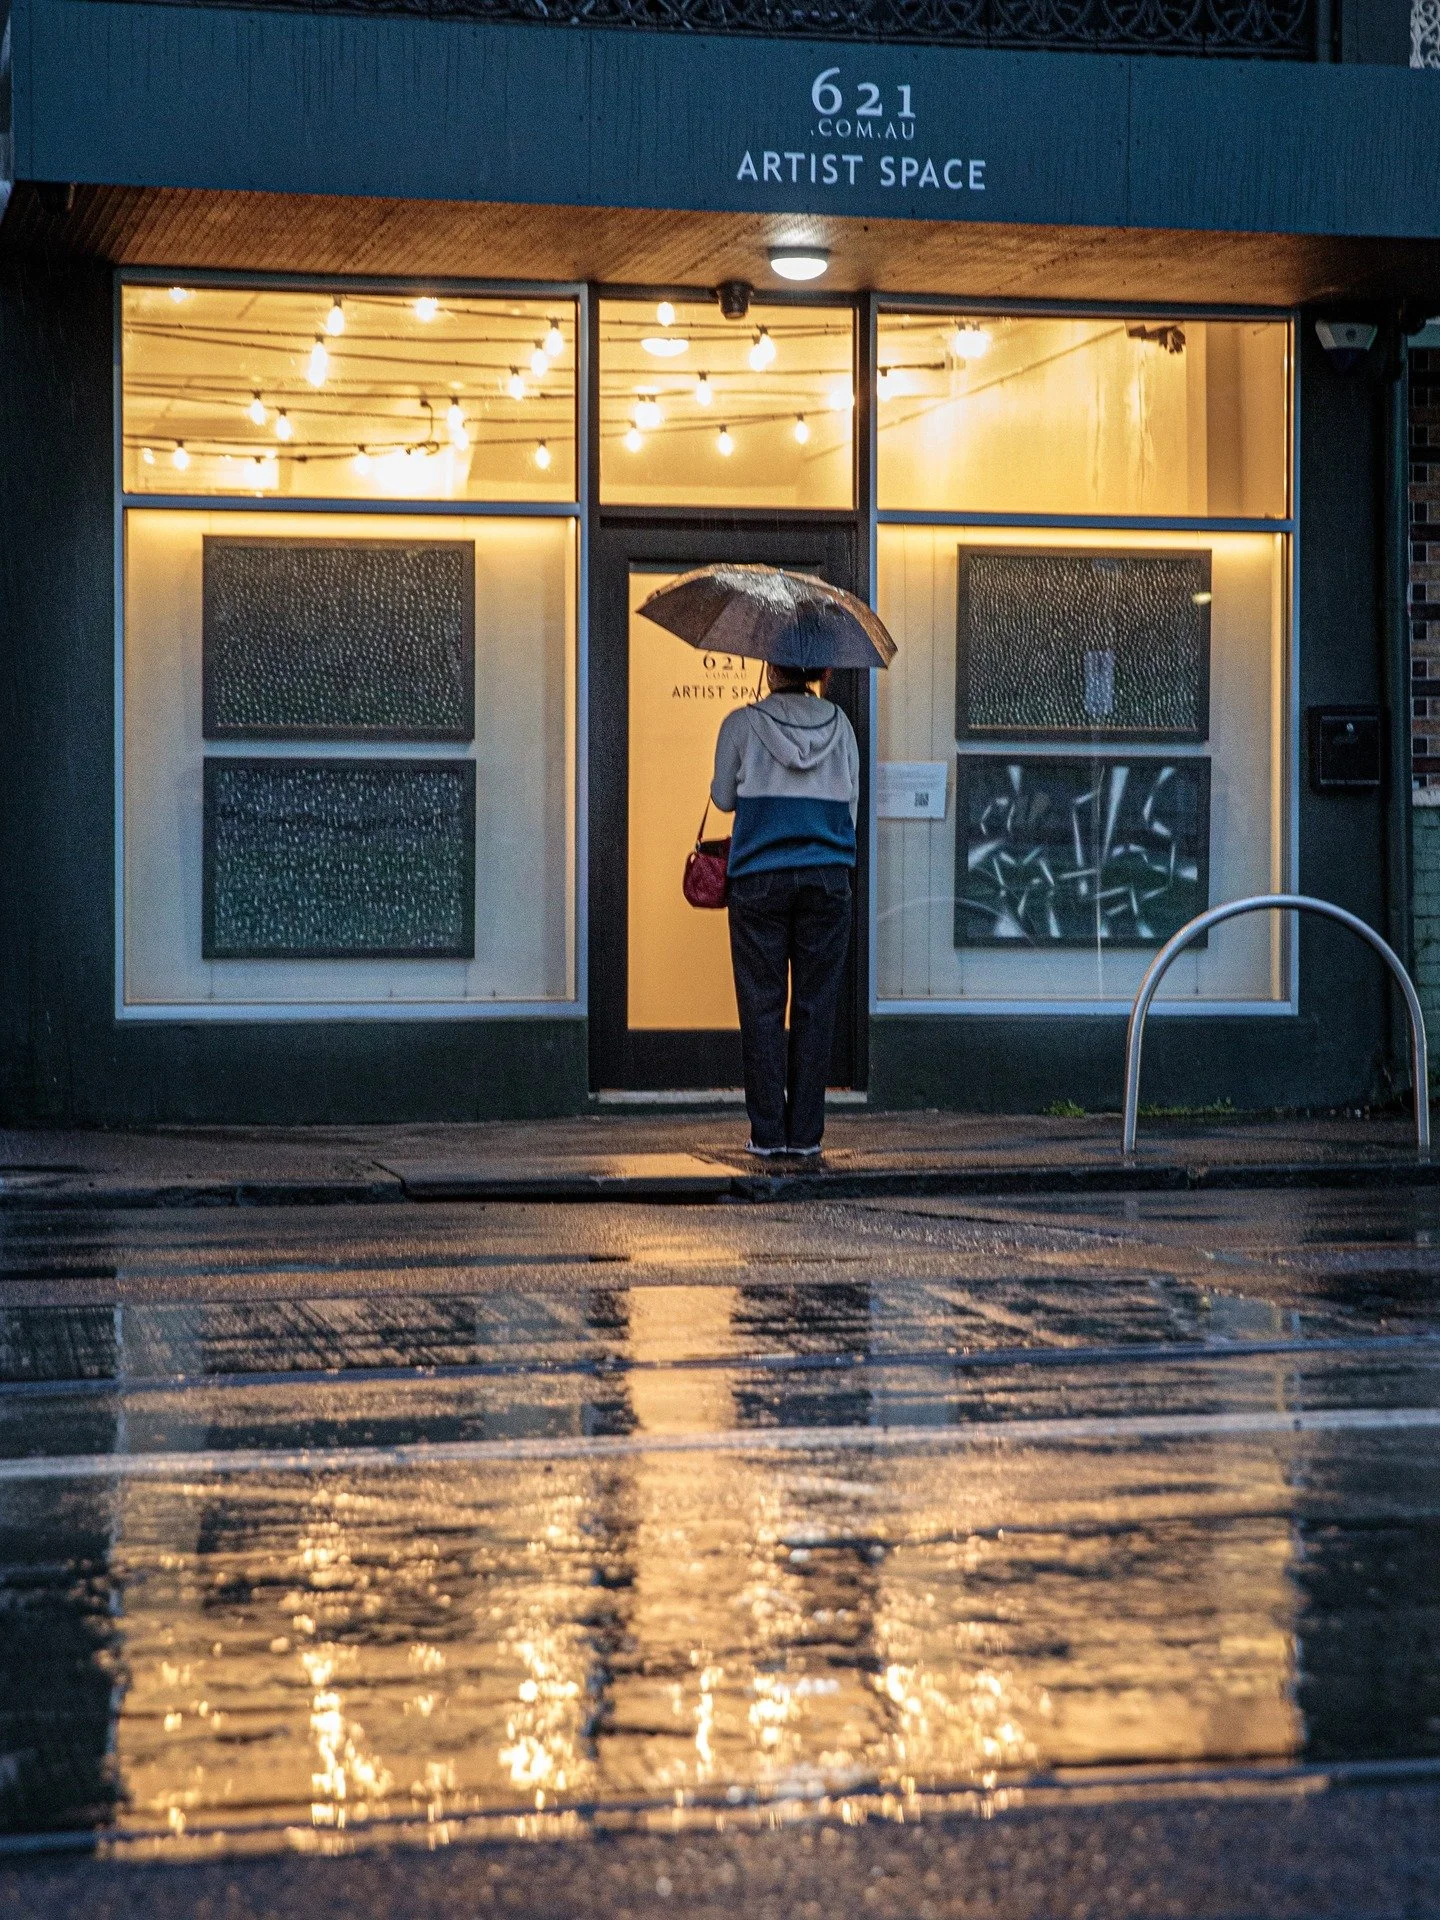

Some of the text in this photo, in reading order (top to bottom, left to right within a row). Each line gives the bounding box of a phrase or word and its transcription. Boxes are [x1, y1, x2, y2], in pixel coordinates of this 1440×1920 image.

[811, 67, 916, 118] 621
[810, 118, 915, 140] .COM.AU
[736, 150, 986, 190] ARTIST SPACE
[703, 650, 745, 670] 621
[672, 685, 725, 699] ARTIST
